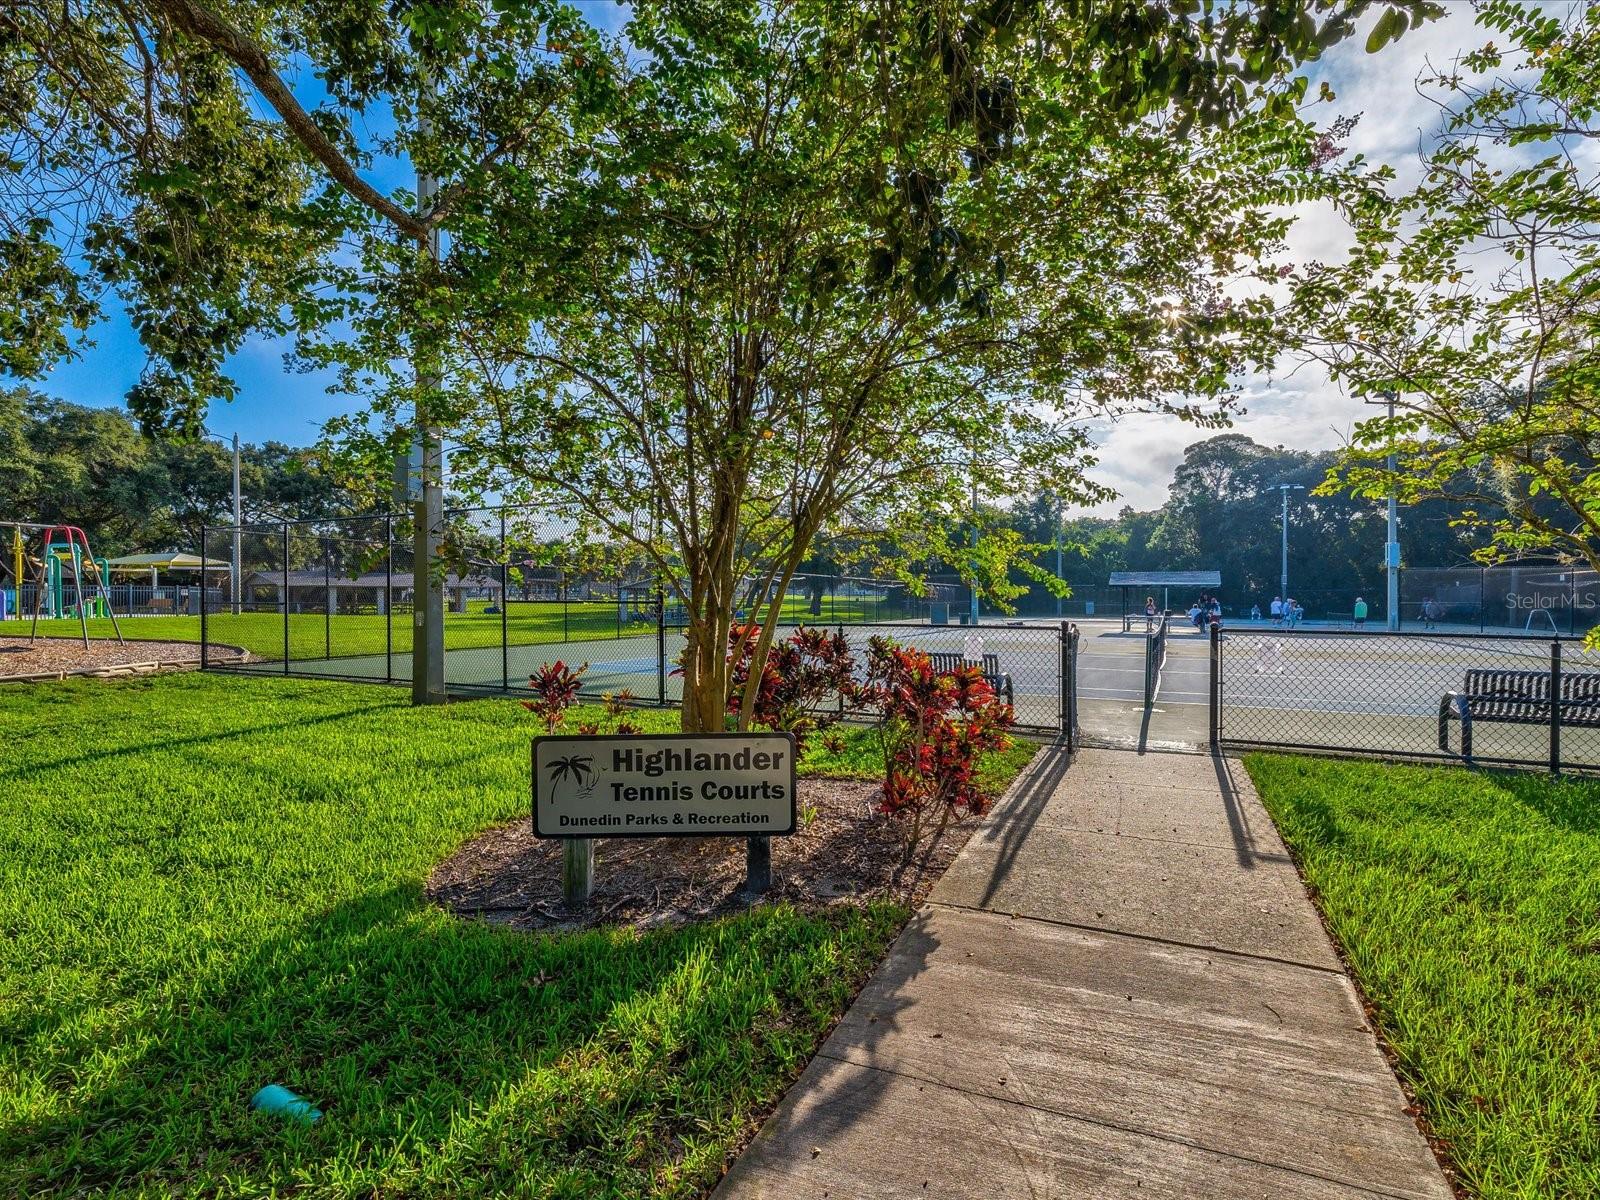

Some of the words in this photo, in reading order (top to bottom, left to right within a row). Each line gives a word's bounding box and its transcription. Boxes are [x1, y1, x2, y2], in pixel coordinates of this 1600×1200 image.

[612, 747, 785, 777] Highlander
[611, 781, 694, 802] Tennis
[700, 780, 785, 800] Courts
[559, 814, 621, 827] Dunedin
[626, 814, 668, 825] Parks
[672, 813, 684, 825] &
[688, 812, 769, 825] Recreation
